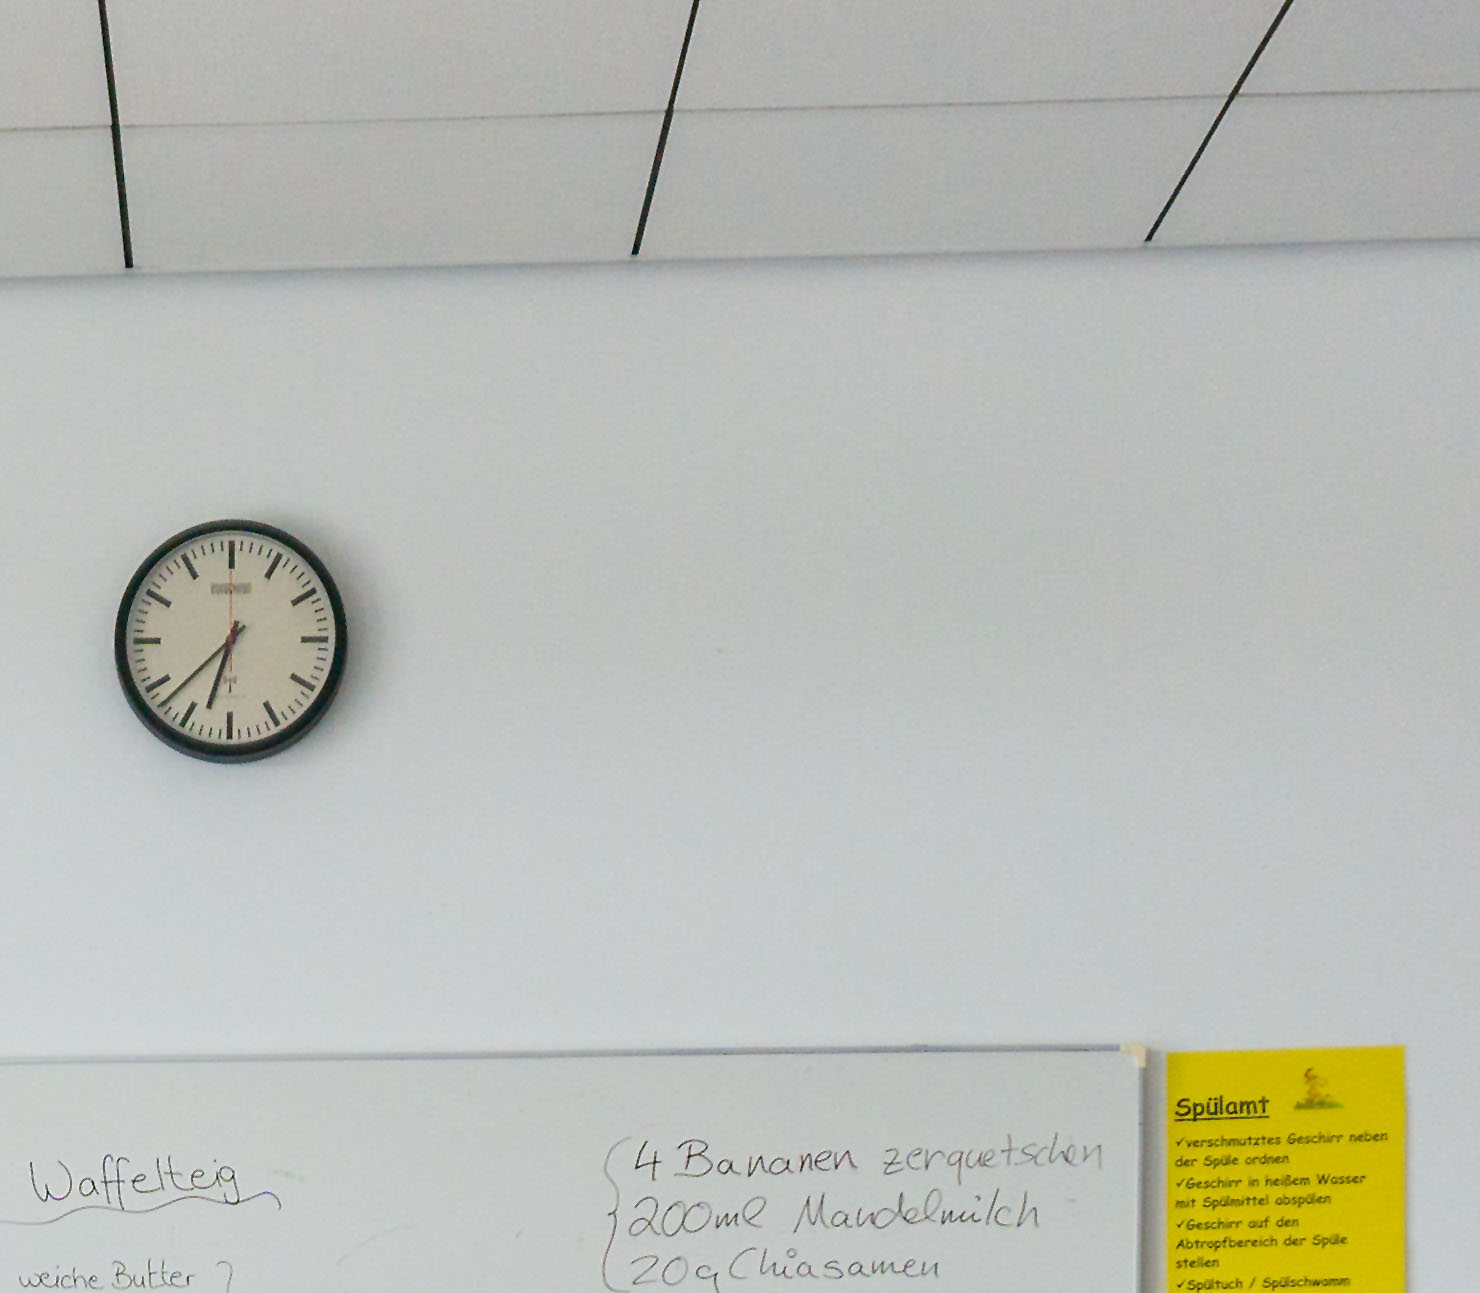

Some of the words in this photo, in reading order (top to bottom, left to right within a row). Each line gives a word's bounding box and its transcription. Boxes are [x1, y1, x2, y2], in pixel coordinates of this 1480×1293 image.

[1174, 1096, 1269, 1120] Spülamt
[1186, 1135, 1281, 1147] verschmutztes
[1286, 1133, 1343, 1144] Geschirr
[1349, 1131, 1388, 1142] neben
[633, 1140, 661, 1181] 4
[674, 1139, 859, 1178] Bananen
[883, 1134, 1103, 1186] zerquetschen
[1174, 1156, 1197, 1167] der
[1202, 1155, 1238, 1168] Spüle
[1244, 1154, 1289, 1165] ordnen
[30, 1154, 240, 1208] Waffelteig
[1185, 1178, 1242, 1190] Geschirr
[1247, 1177, 1259, 1187] in
[1264, 1175, 1310, 1187] heißem
[1316, 1173, 1365, 1186] Wasser
[1174, 1198, 1196, 1209] mit
[1202, 1195, 1269, 1209] Spülmittel
[1275, 1194, 1331, 1208] abspülen
[628, 1196, 766, 1237] 200ml
[794, 1188, 1040, 1234] Mandelmilch
[1186, 1219, 1242, 1230] Geschirr
[1247, 1217, 1269, 1229] auf
[1275, 1217, 1299, 1227] den
[1175, 1236, 1277, 1250] Abtropfbereich
[1283, 1236, 1306, 1246] der
[1311, 1234, 1348, 1247] Spüle
[728, 1247, 941, 1281] Chiasamen
[1175, 1257, 1219, 1269] stellen
[18, 1266, 104, 1289] weiche
[112, 1258, 195, 1289] Butter
[1186, 1279, 1243, 1292] Spültuch
[1248, 1277, 1256, 1289] /
[1262, 1276, 1350, 1289] Spülschwamm
